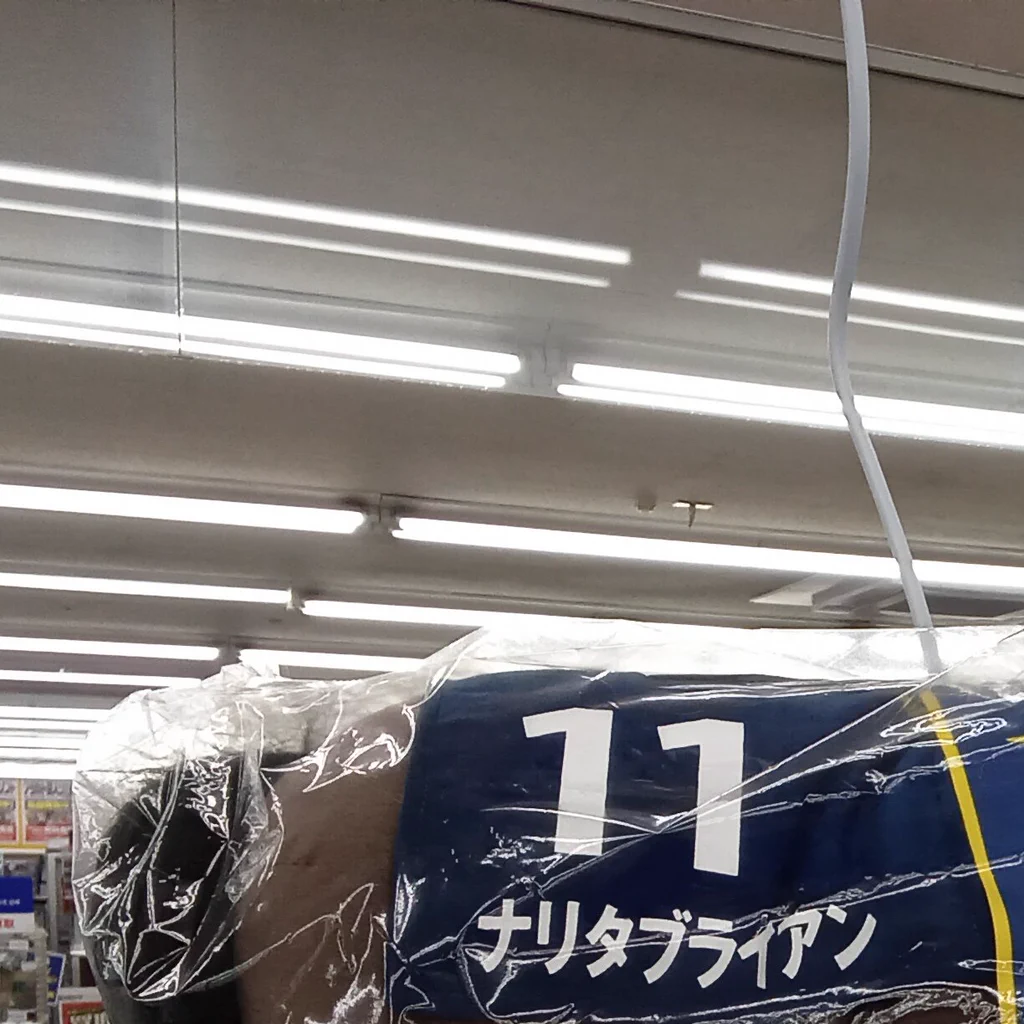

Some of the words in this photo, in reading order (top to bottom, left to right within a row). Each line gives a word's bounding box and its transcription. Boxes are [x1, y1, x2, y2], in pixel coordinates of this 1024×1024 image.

[521, 707, 745, 877] 11
[477, 898, 877, 990] ナリタブライアン
